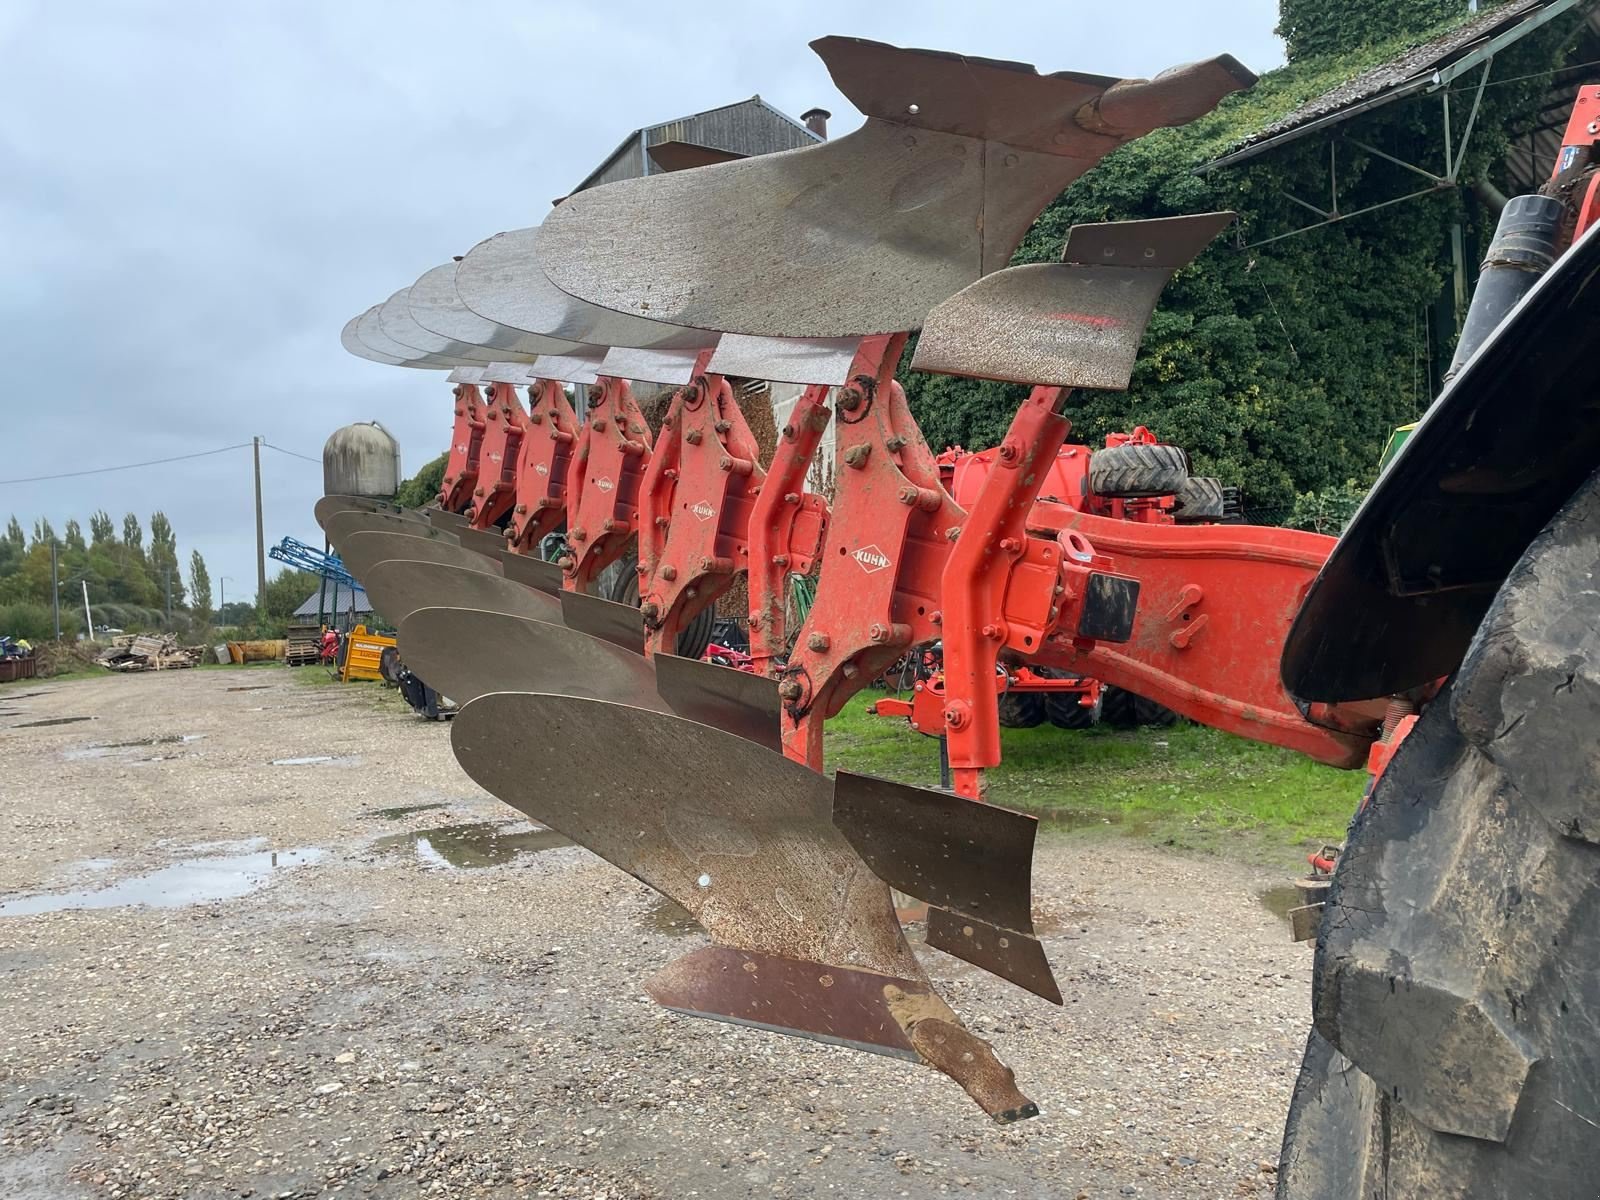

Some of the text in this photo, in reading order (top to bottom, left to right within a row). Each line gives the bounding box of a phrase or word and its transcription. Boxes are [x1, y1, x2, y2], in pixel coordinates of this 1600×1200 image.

[598, 479, 613, 489] KUHN
[693, 504, 713, 517] KUHN
[856, 550, 887, 568] KUHN
